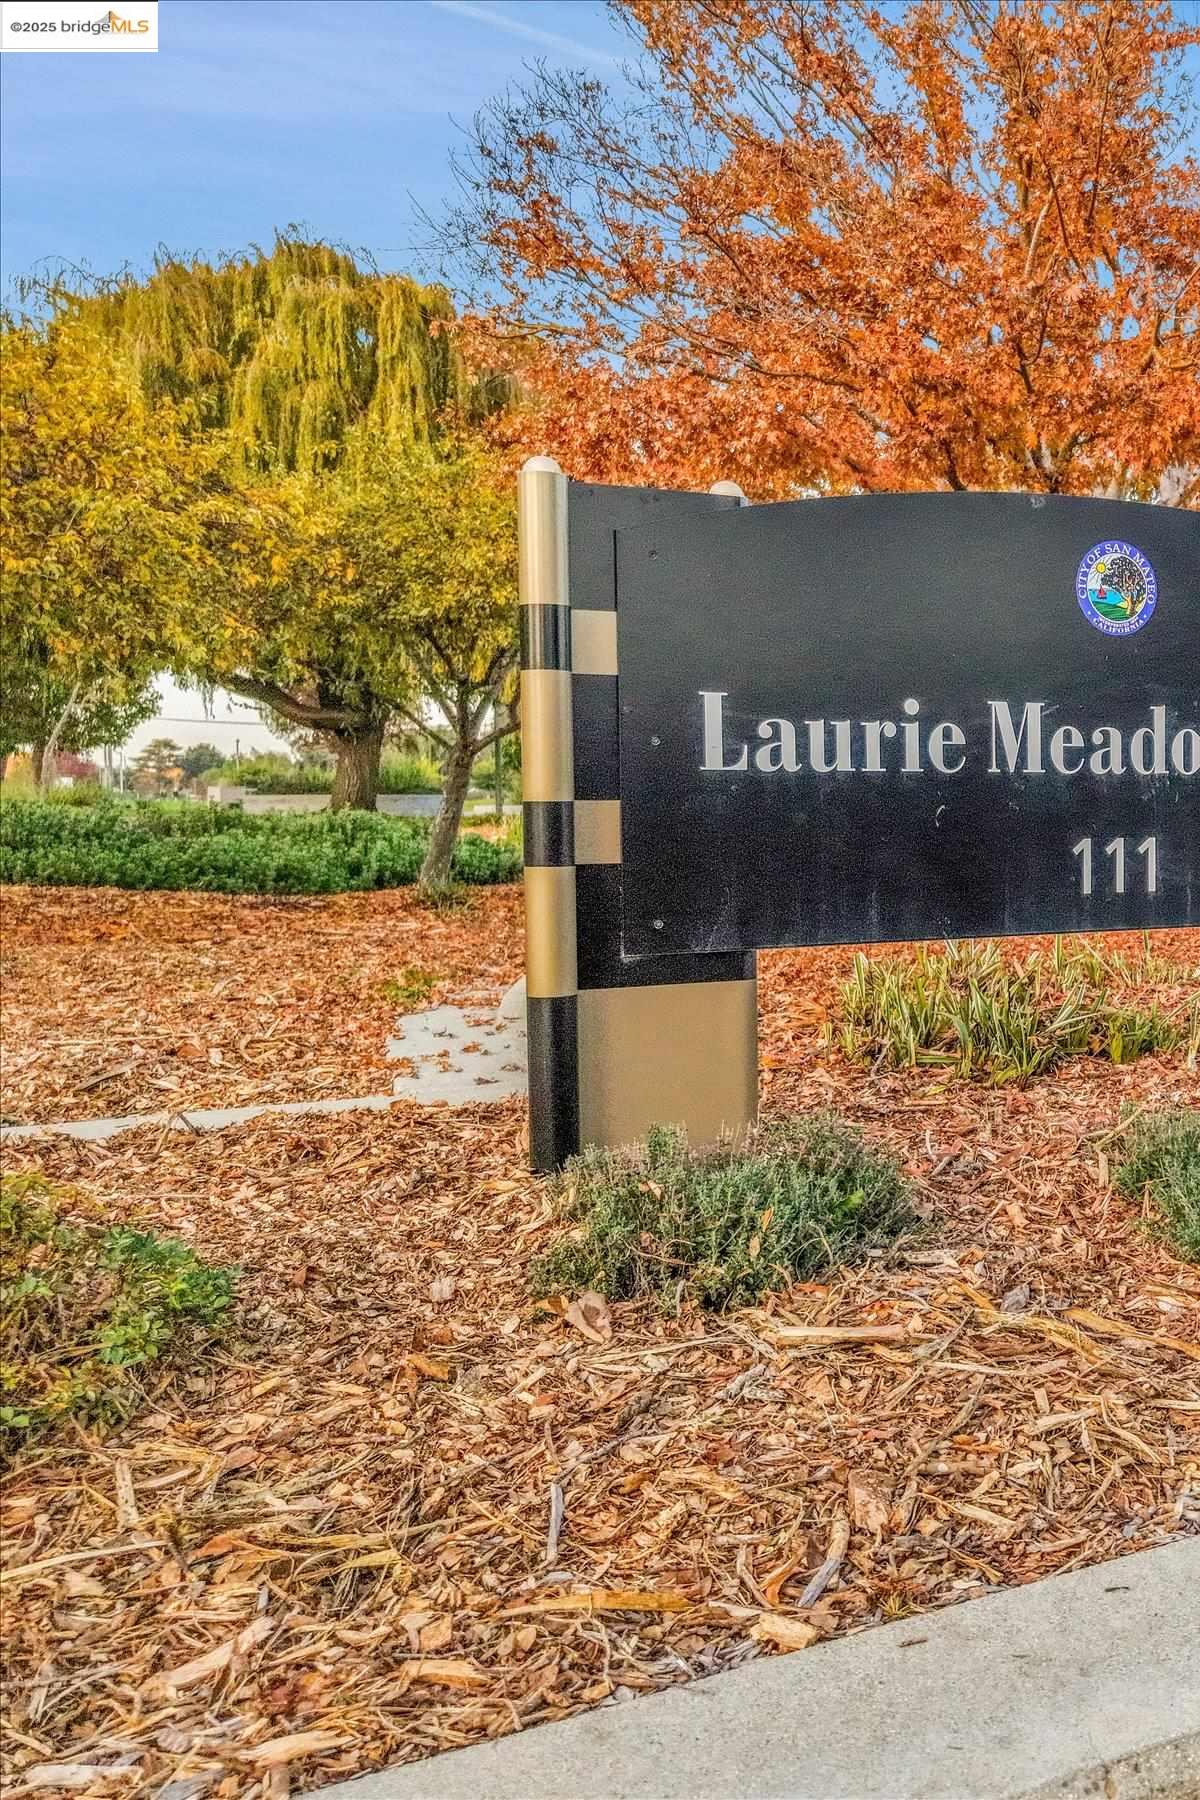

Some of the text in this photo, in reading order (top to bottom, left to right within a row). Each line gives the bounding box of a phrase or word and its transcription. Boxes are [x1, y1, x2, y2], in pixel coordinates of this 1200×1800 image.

[1078, 543, 1156, 604] CITY OF SAN MATEO
[1093, 617, 1144, 633] CALIFORNIA
[699, 690, 968, 776] Laurie
[1072, 837, 1158, 896] 111
